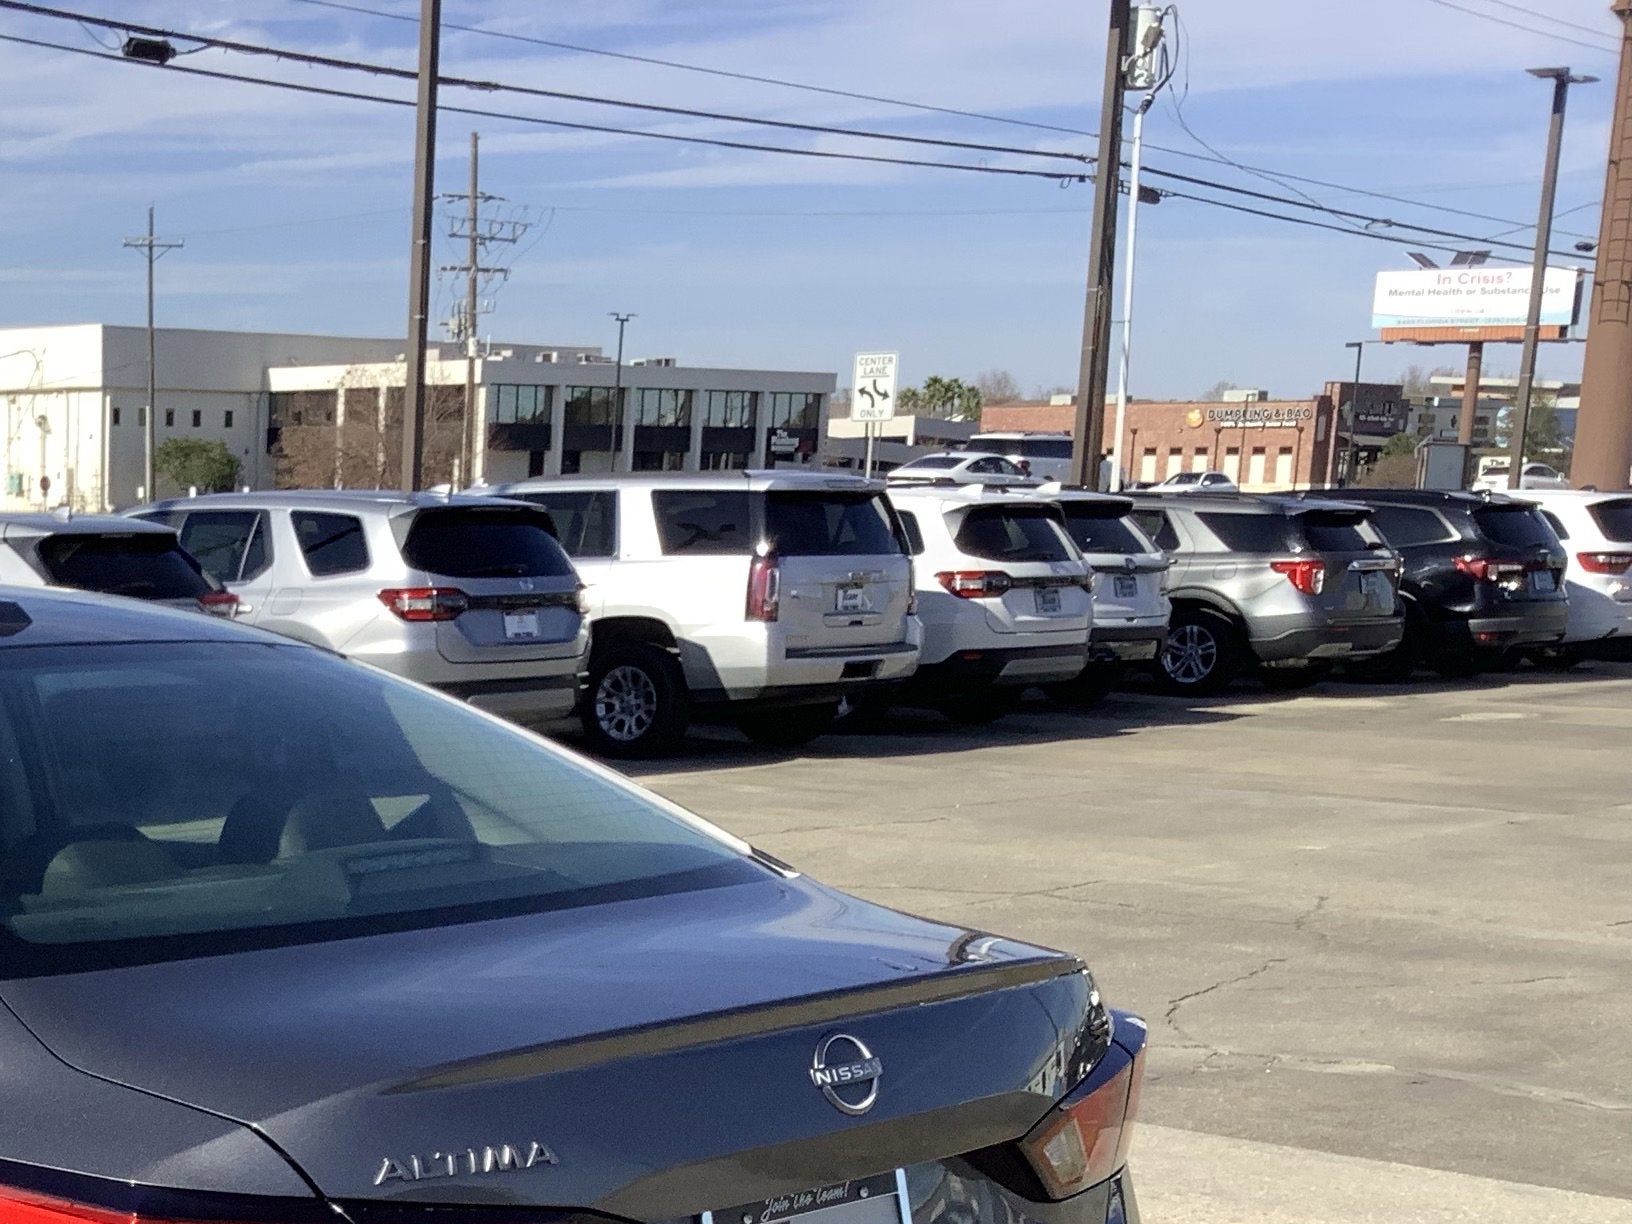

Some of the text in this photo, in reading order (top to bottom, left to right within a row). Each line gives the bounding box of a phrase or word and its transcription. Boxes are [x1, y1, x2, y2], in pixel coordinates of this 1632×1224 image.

[1437, 271, 1512, 285] In Crisis?
[1389, 288, 1424, 297] Mental
[1428, 287, 1462, 296] Health
[1466, 287, 1476, 295] or
[1480, 286, 1529, 295] Substanc
[859, 356, 894, 366] CENTER
[864, 366, 888, 375] LANE
[860, 409, 884, 418] ONLY
[1208, 408, 1311, 419] DUMPLING & BAO
[814, 1060, 881, 1086] NISSAN
[374, 1142, 560, 1185] ALTIMA
[760, 1196, 790, 1222] Join
